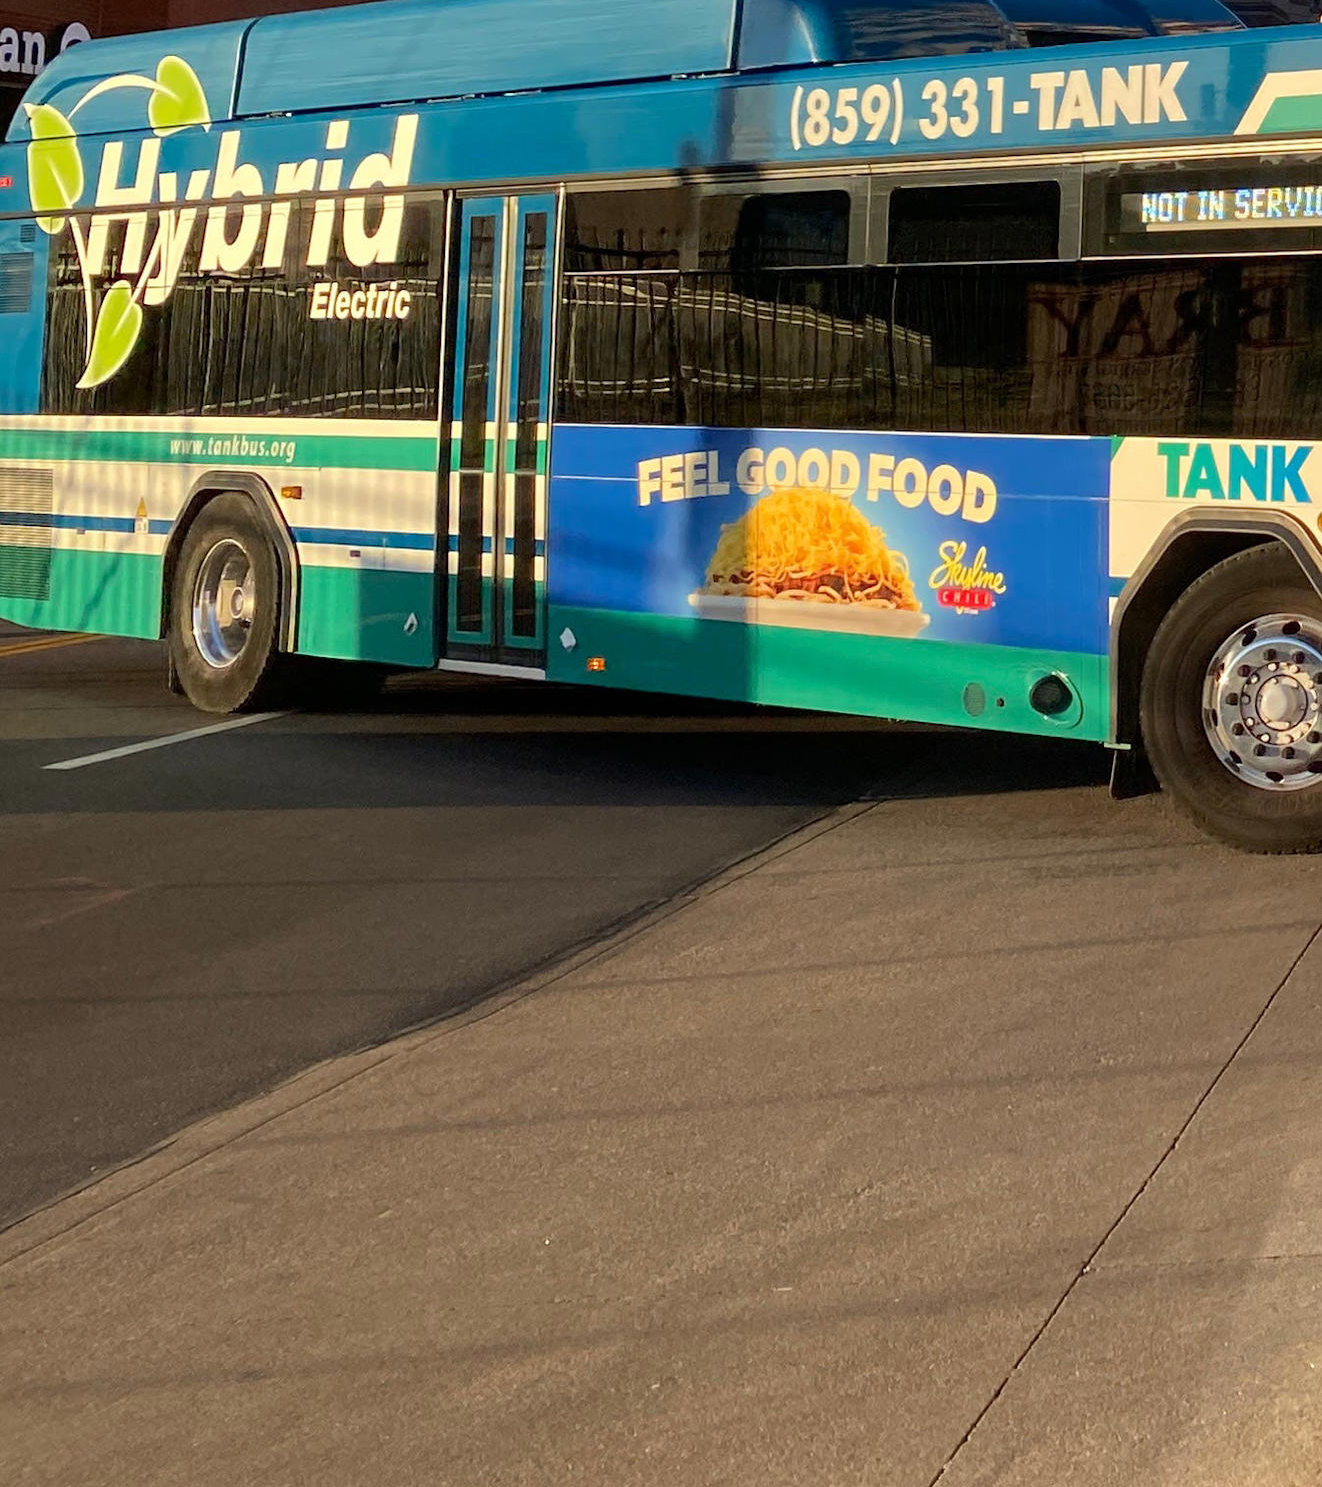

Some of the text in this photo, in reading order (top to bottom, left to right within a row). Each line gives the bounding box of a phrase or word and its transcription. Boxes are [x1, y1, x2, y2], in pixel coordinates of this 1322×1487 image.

[789, 60, 1190, 151] (859) 331-TANK
[87, 114, 419, 305] Hybrid
[1141, 191, 1188, 223] NOT
[1197, 189, 1225, 220] IN
[309, 281, 411, 320] Electric
[170, 435, 296, 463] www.tankbus.org
[1157, 442, 1314, 503] TANK
[638, 447, 997, 523] FEEL GOOD FOOD
[928, 540, 1007, 595] Skyline
[942, 591, 989, 605] CHILI
